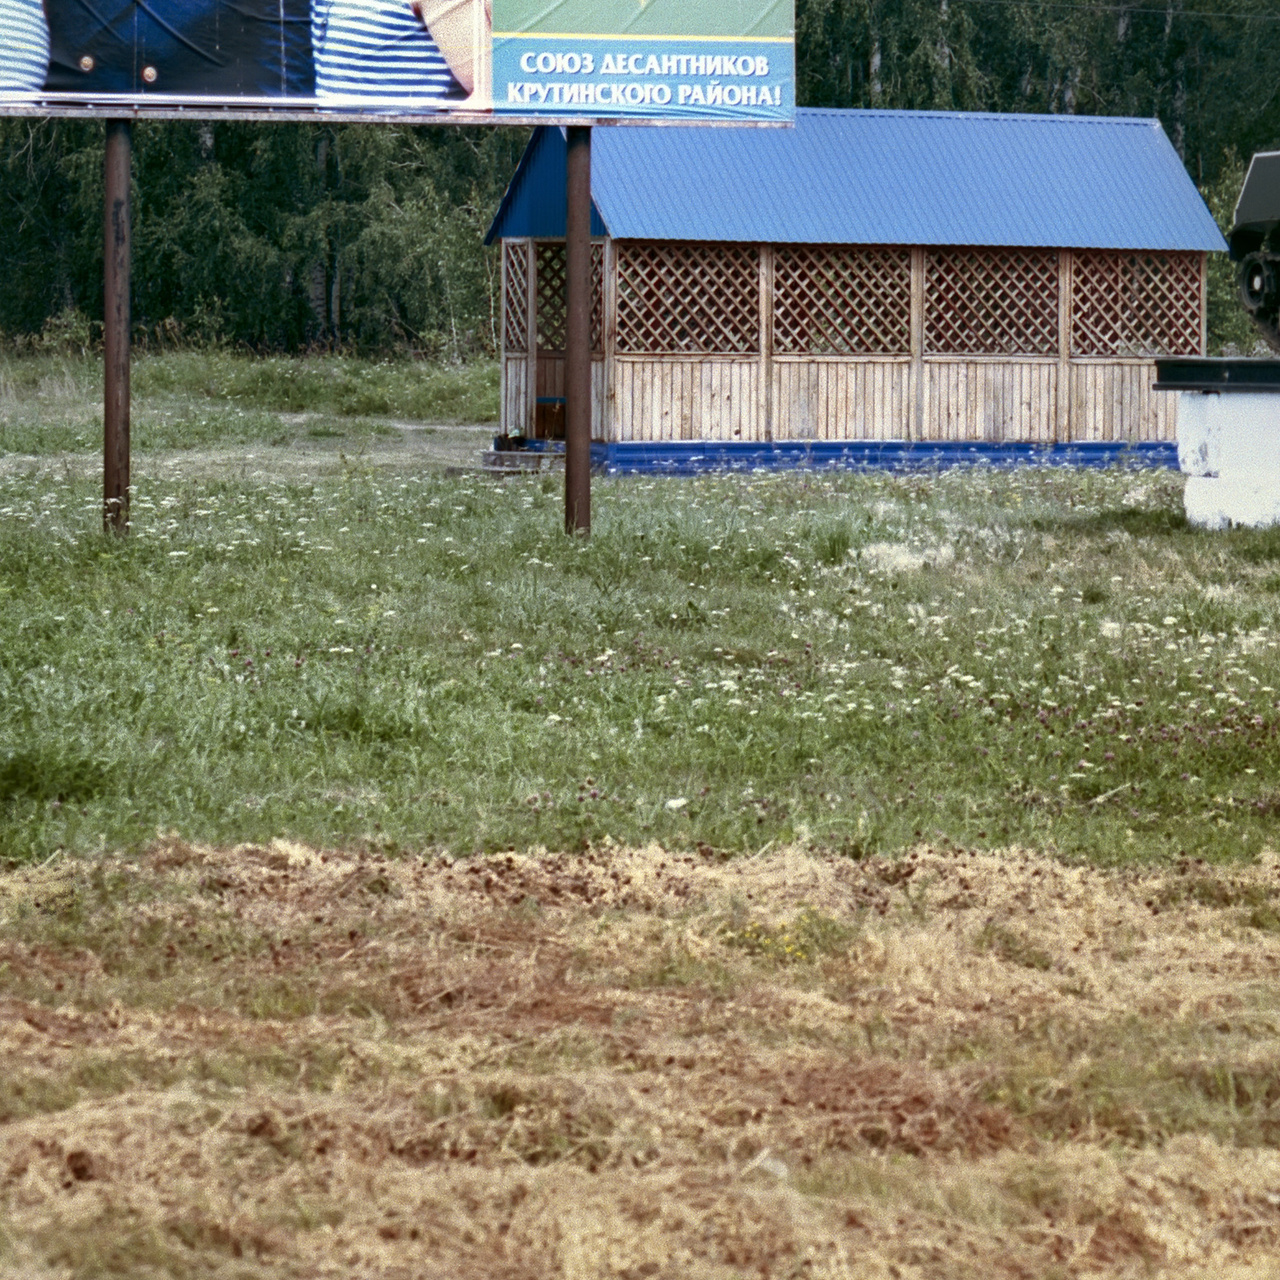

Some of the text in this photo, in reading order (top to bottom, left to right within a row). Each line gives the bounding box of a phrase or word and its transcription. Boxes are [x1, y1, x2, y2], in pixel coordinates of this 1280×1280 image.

[520, 52, 769, 77] СОЮЗ ДЕСАНТНИКОВ
[507, 81, 782, 106] КРУТИНСКОГО РАЙОНА!
